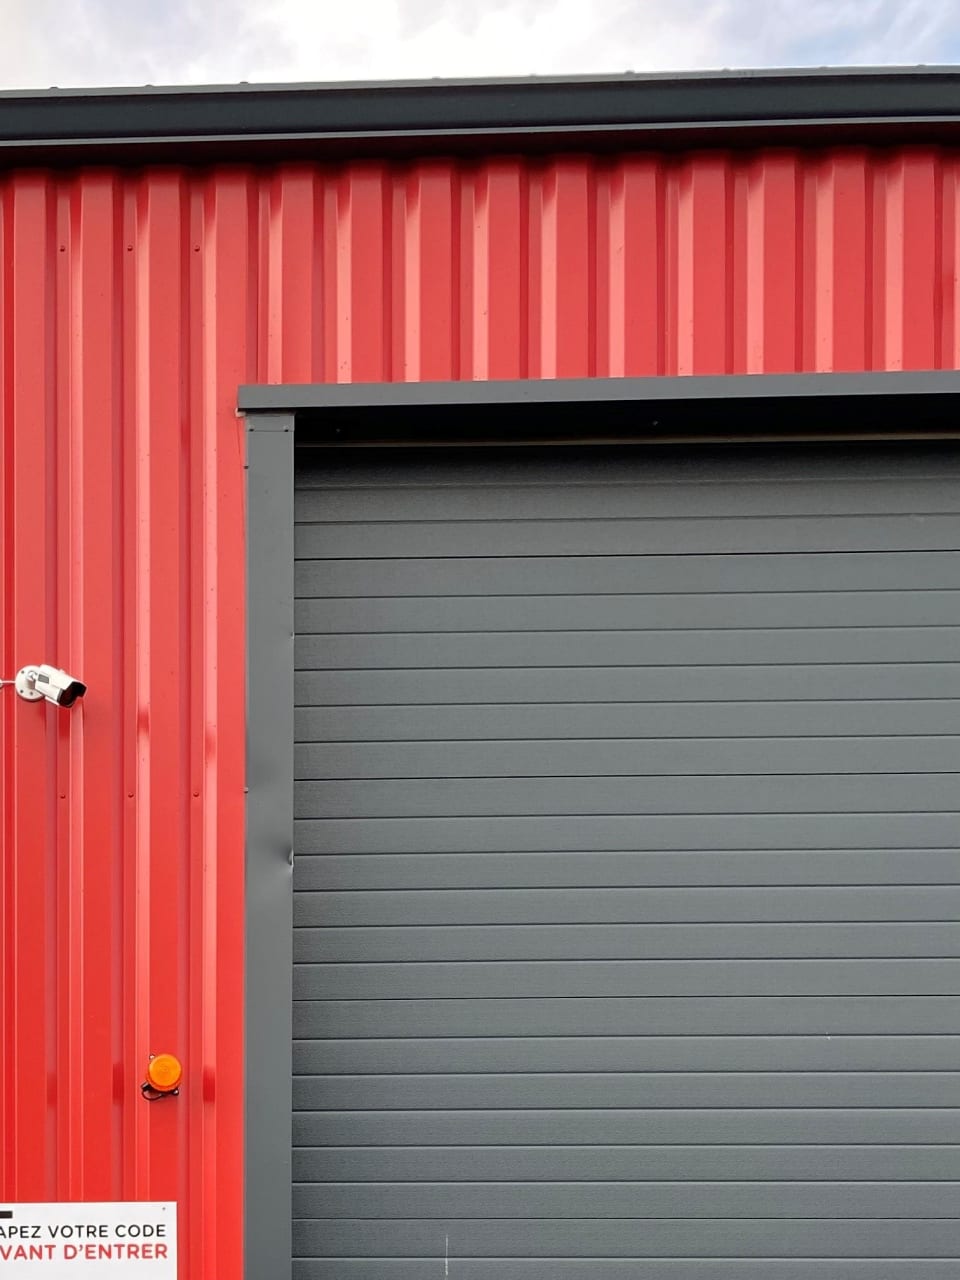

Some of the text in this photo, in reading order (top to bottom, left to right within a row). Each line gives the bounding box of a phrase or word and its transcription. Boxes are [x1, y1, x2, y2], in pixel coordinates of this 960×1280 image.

[47, 1224, 109, 1239] VOTRE
[114, 1224, 167, 1238] CODE
[63, 1243, 168, 1260] D'ENTRER
